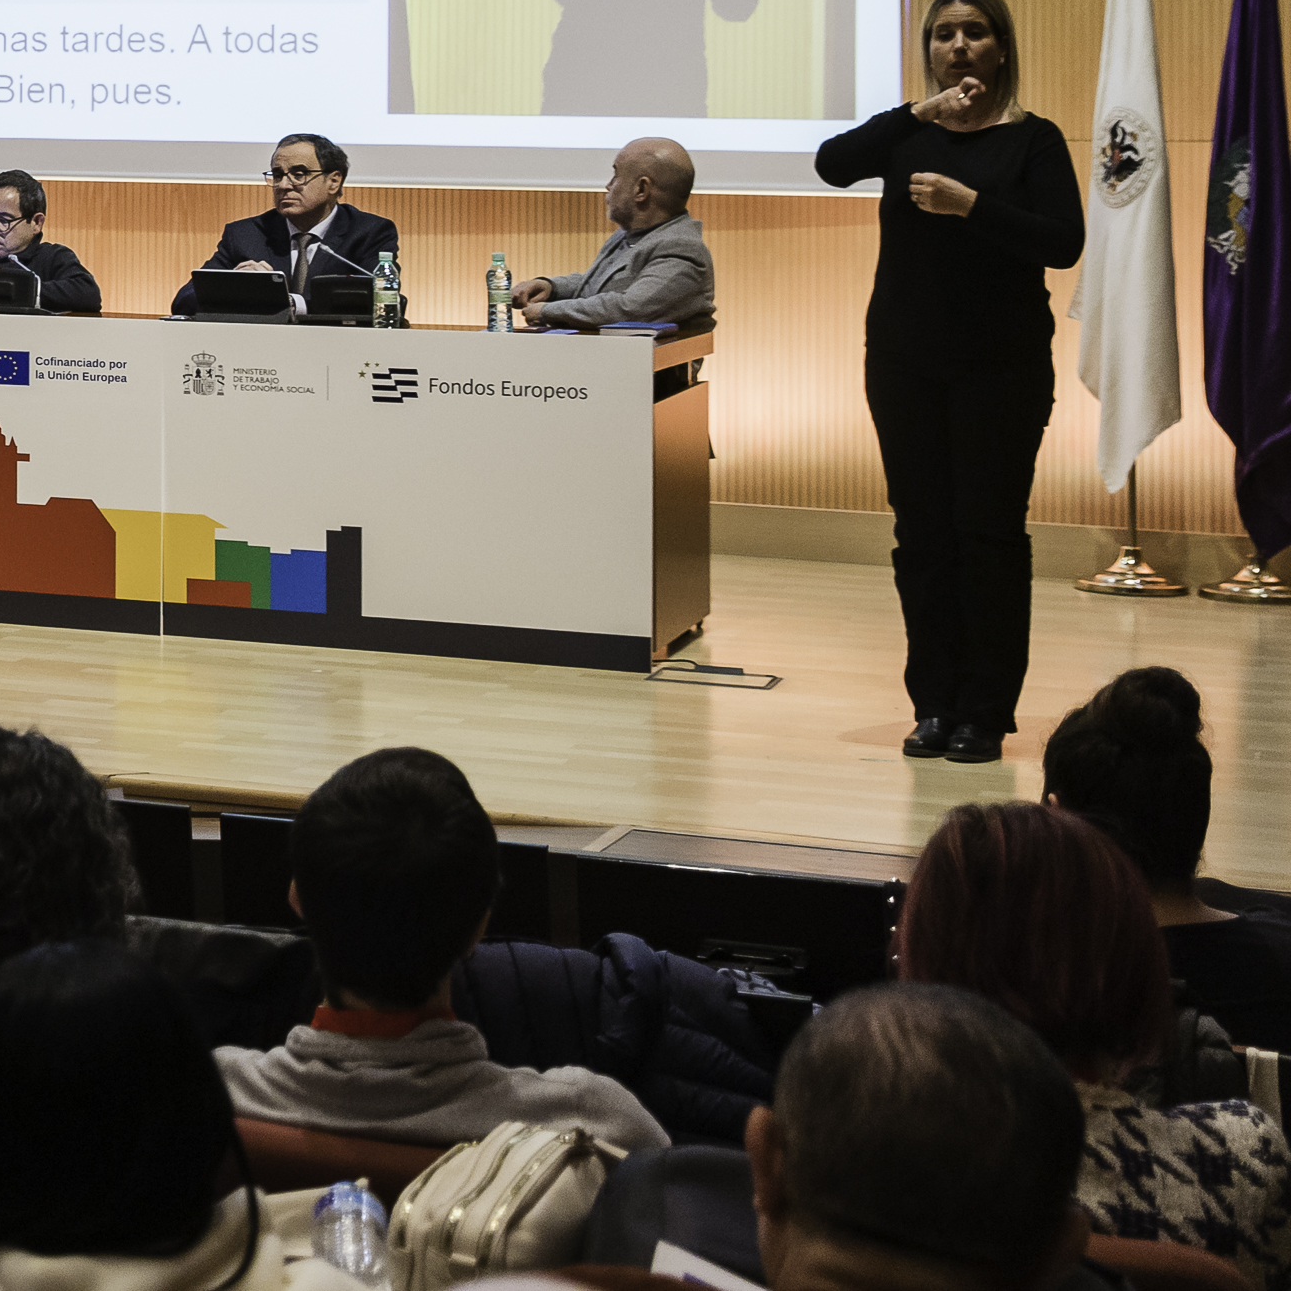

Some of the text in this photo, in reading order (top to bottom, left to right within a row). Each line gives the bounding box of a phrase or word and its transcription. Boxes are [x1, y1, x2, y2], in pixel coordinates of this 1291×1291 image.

[59, 23, 175, 53] tardes.
[186, 23, 213, 54] A
[222, 23, 320, 54] todas
[91, 80, 182, 112] pues.
[35, 356, 128, 371] Cofinanciado por
[35, 369, 128, 385] la Unión Europea
[233, 368, 277, 376] MINISTERIO
[233, 375, 280, 385] DE TRABAJO
[240, 384, 284, 392] ECONOMÍA
[286, 386, 315, 394] SOCIAL
[428, 378, 588, 402] Fondos Europeos
